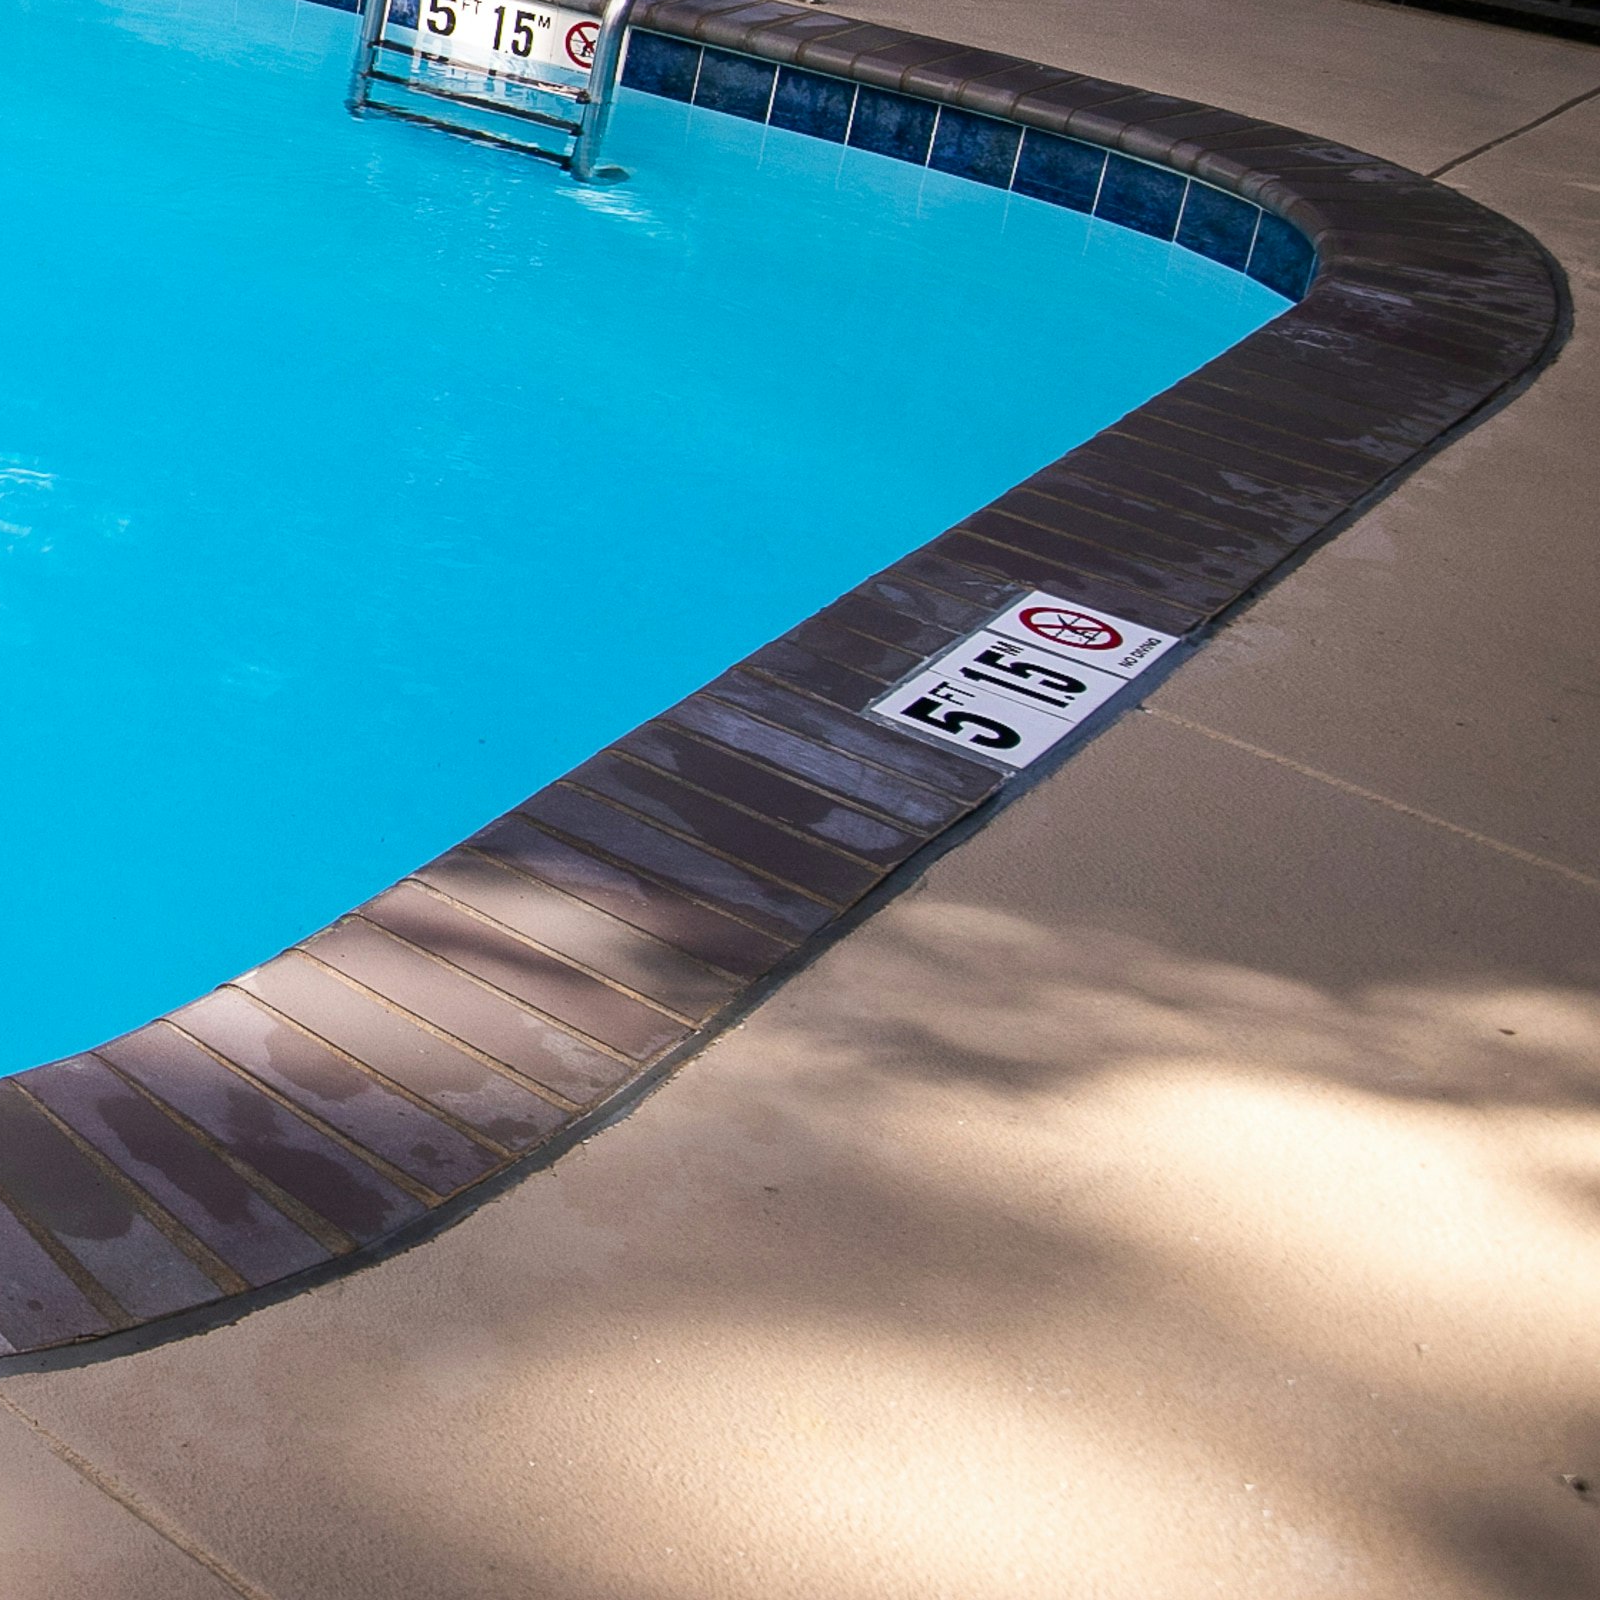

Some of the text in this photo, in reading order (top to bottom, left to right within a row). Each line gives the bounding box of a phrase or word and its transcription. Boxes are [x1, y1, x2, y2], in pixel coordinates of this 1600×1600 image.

[538, 15, 551, 29] M
[1118, 656, 1138, 669] NO
[900, 641, 1087, 750] 5 FT 1.5 M
